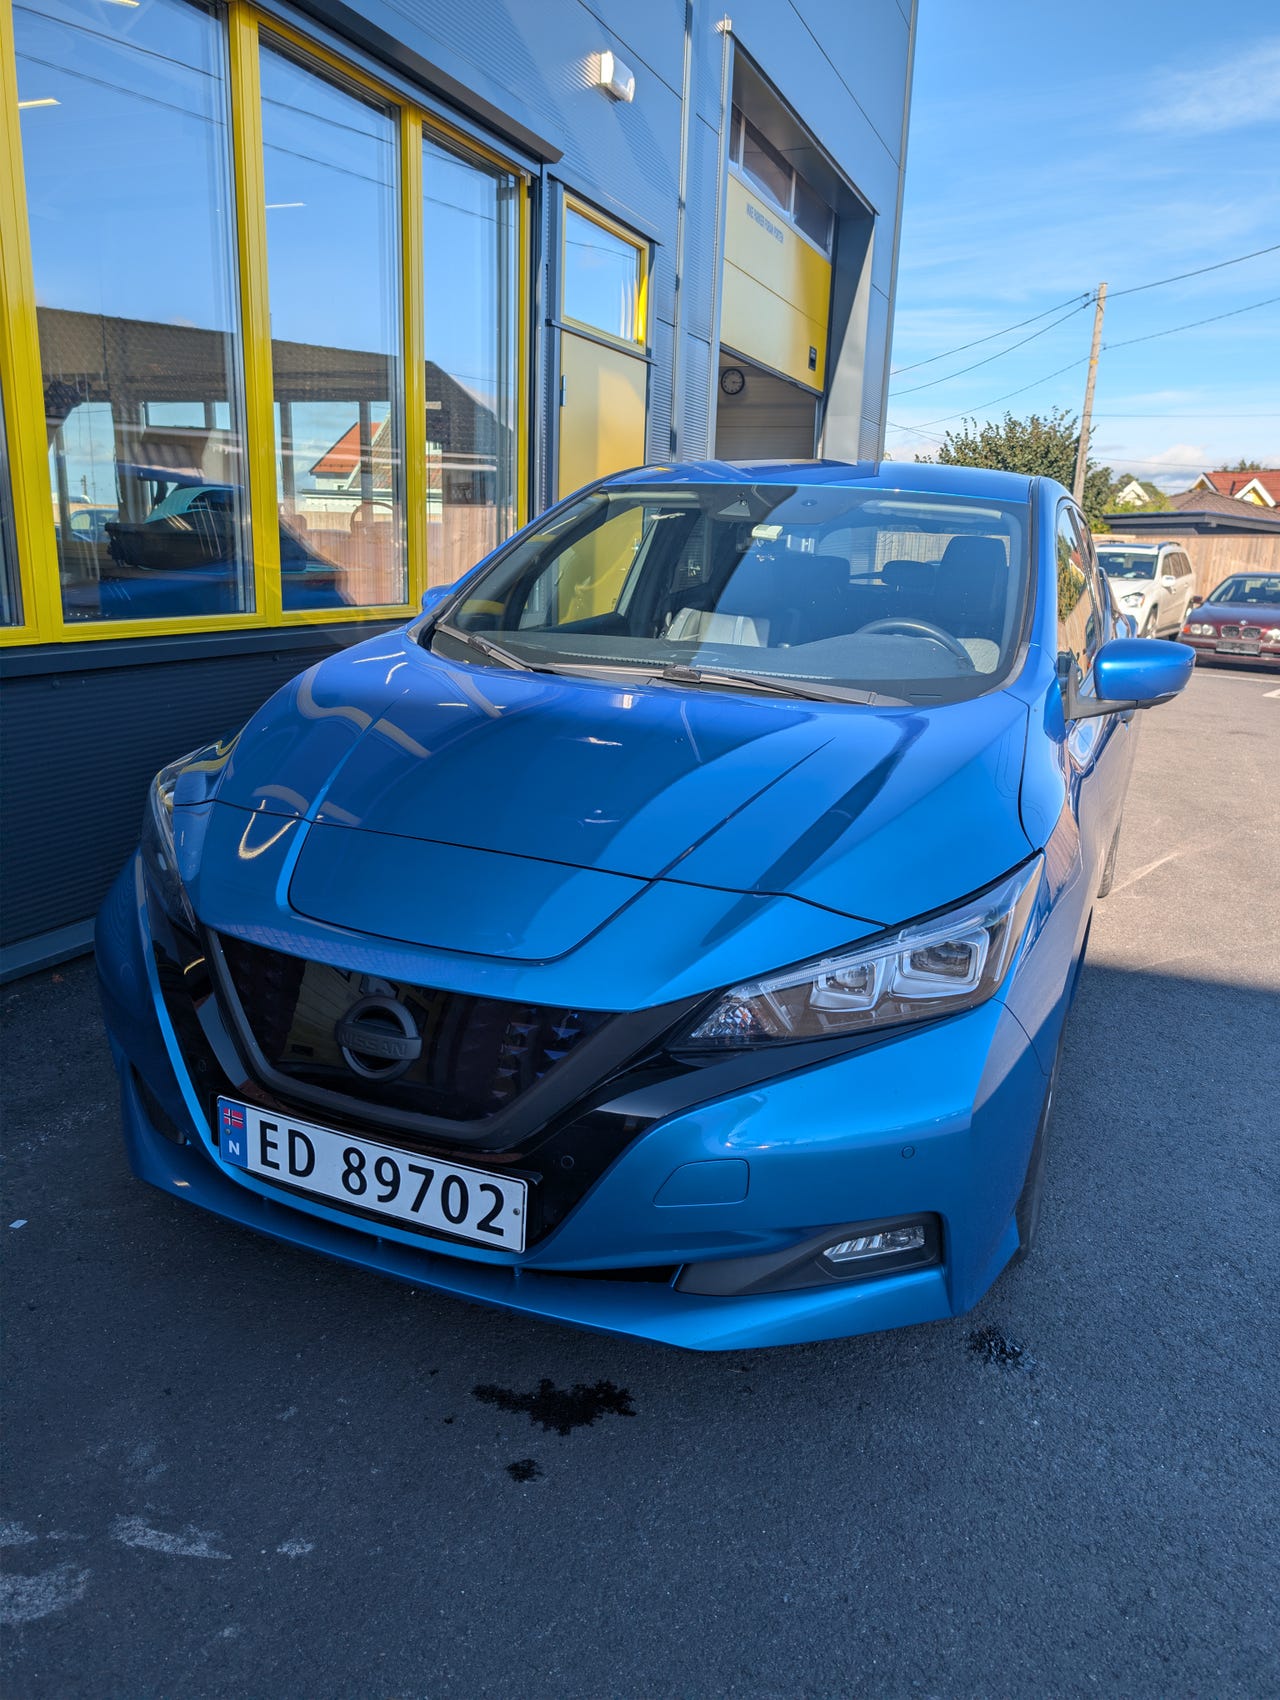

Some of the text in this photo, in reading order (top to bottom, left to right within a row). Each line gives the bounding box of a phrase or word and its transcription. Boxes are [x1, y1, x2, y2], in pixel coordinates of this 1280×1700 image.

[340, 1031, 407, 1057] NISSAN
[228, 1140, 240, 1156] N
[259, 1119, 505, 1237] ED 89702
